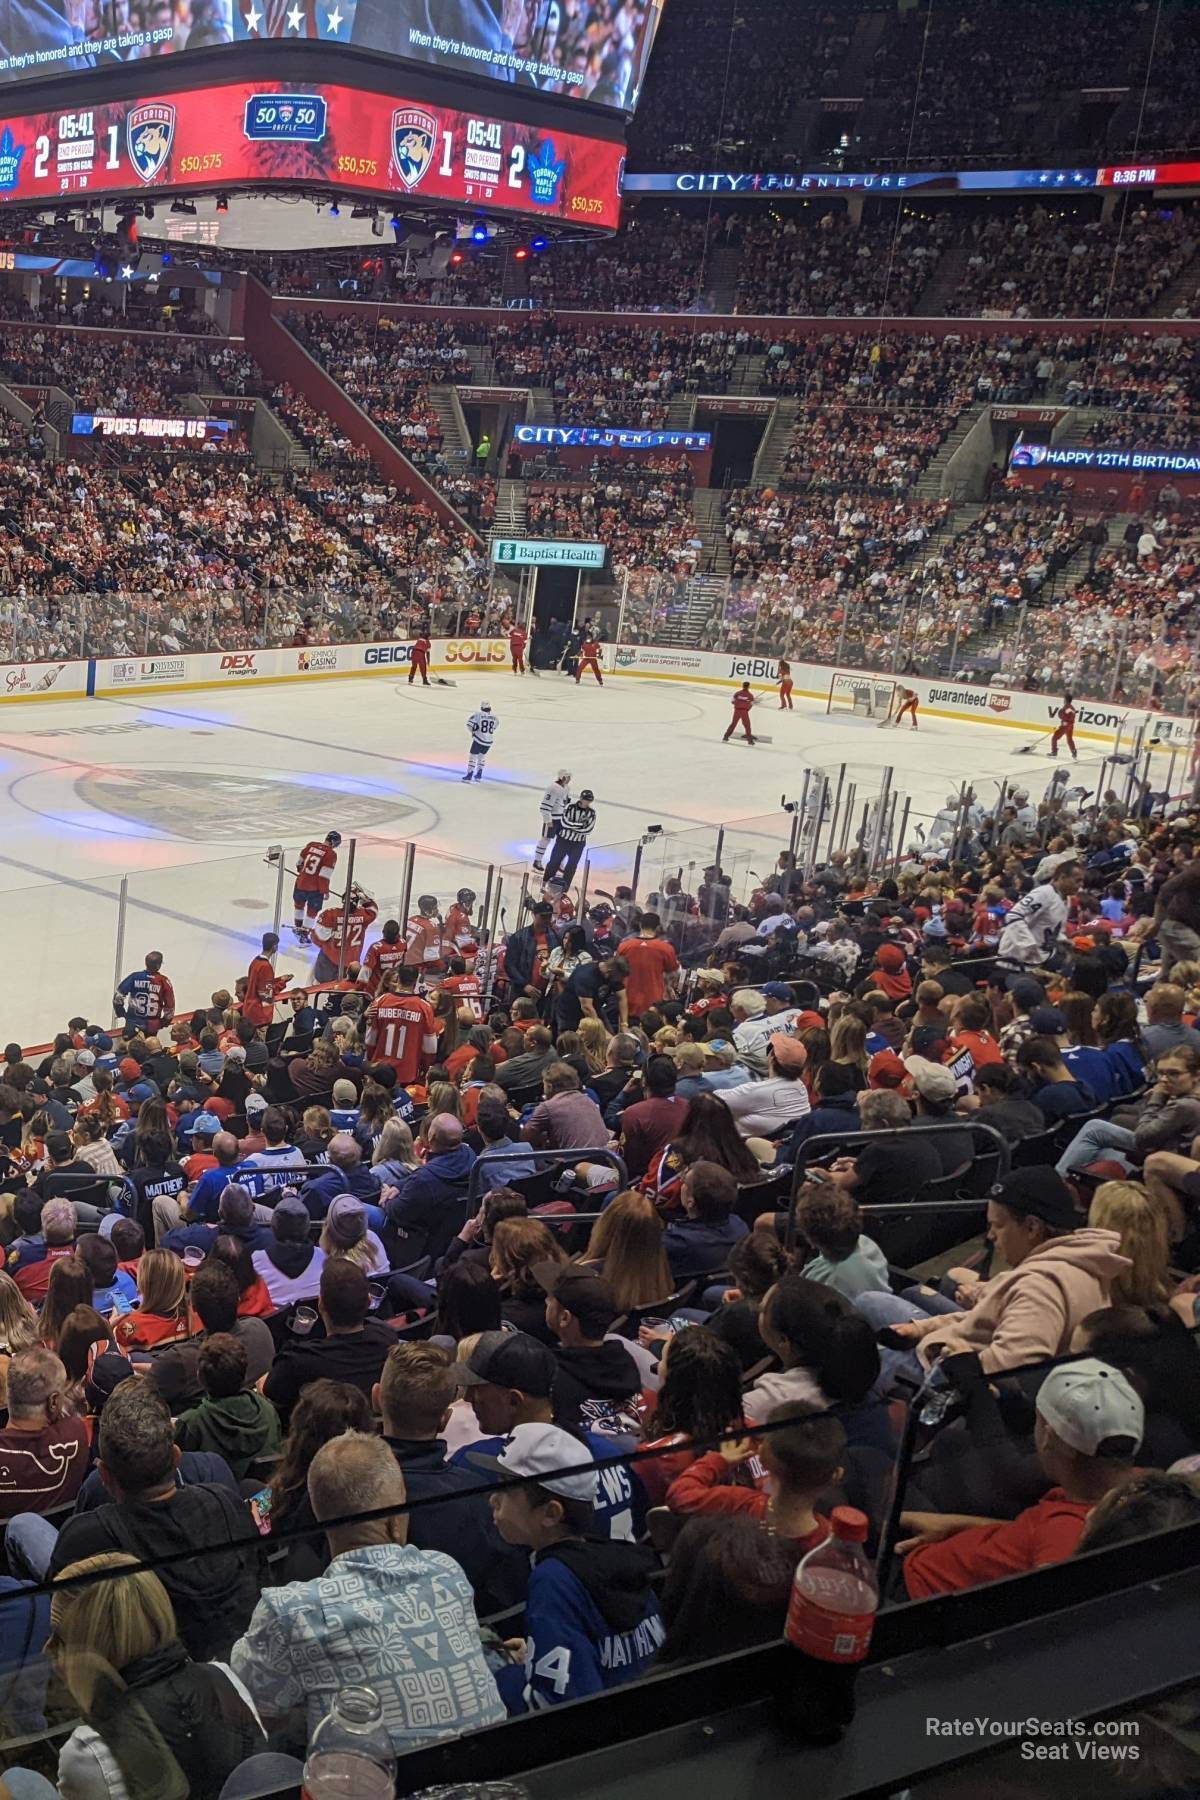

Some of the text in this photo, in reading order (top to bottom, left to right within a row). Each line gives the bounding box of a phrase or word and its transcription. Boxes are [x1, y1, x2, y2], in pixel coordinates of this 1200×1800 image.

[10, 53, 35, 69] they're
[36, 48, 67, 63] honored
[68, 43, 83, 57] and
[84, 40, 102, 55] they
[104, 37, 117, 50] are
[118, 33, 144, 49] taking
[145, 32, 152, 43] a
[153, 26, 173, 44] gasp
[409, 28, 584, 86] When they're honored and they are taking a gasp
[132, 109, 170, 124] FLORIDA
[256, 108, 316, 124] 50 50
[398, 114, 432, 132] FLORIDA
[58, 112, 94, 139] 05:41
[467, 119, 501, 148] 05:41
[34, 135, 50, 178] 2
[72, 143, 92, 156] PERIOD
[106, 126, 120, 170] 1
[439, 131, 453, 176] 1
[57, 162, 73, 172] SHOTS
[81, 160, 93, 169] GOAL
[180, 153, 222, 173] $50,575
[338, 156, 377, 176] $50,575
[466, 151, 499, 168] 2ND PERIOD
[508, 145, 525, 188] 2
[464, 169, 480, 180] SHOTS
[488, 173, 499, 184] GOAL
[533, 169, 557, 182] TORONTO
[535, 178, 553, 189] MAPLE
[676, 174, 744, 191] CITY
[768, 177, 907, 188] FURNITURE
[1113, 169, 1156, 183] 8:36 PM
[535, 186, 553, 196] LEAFS
[571, 196, 603, 213] $50,575
[0, 253, 15, 270] US
[992, 410, 1008, 420] 125
[93, 417, 206, 438] HEROES AMONG US
[517, 427, 574, 443] CITY
[593, 433, 706, 446] FURNITURE
[1047, 451, 1094, 464] HAPPY
[1096, 453, 1128, 466] 12TH
[519, 547, 598, 561] Baptist Health
[311, 649, 337, 658] SEMINOLE
[445, 641, 506, 662] SOLIS
[155, 660, 185, 670] SYLVESTER
[220, 654, 256, 669] DEX
[311, 657, 337, 667] CASINO
[729, 657, 780, 680] jetBlu
[928, 688, 1010, 707] guaranteed Rate
[481, 720, 495, 734] 88
[302, 854, 321, 875] 13
[134, 980, 161, 993] MATT KOV
[135, 992, 159, 1016] 36
[384, 1024, 407, 1059] 11
[144, 1176, 183, 1198] MATTHEWS
